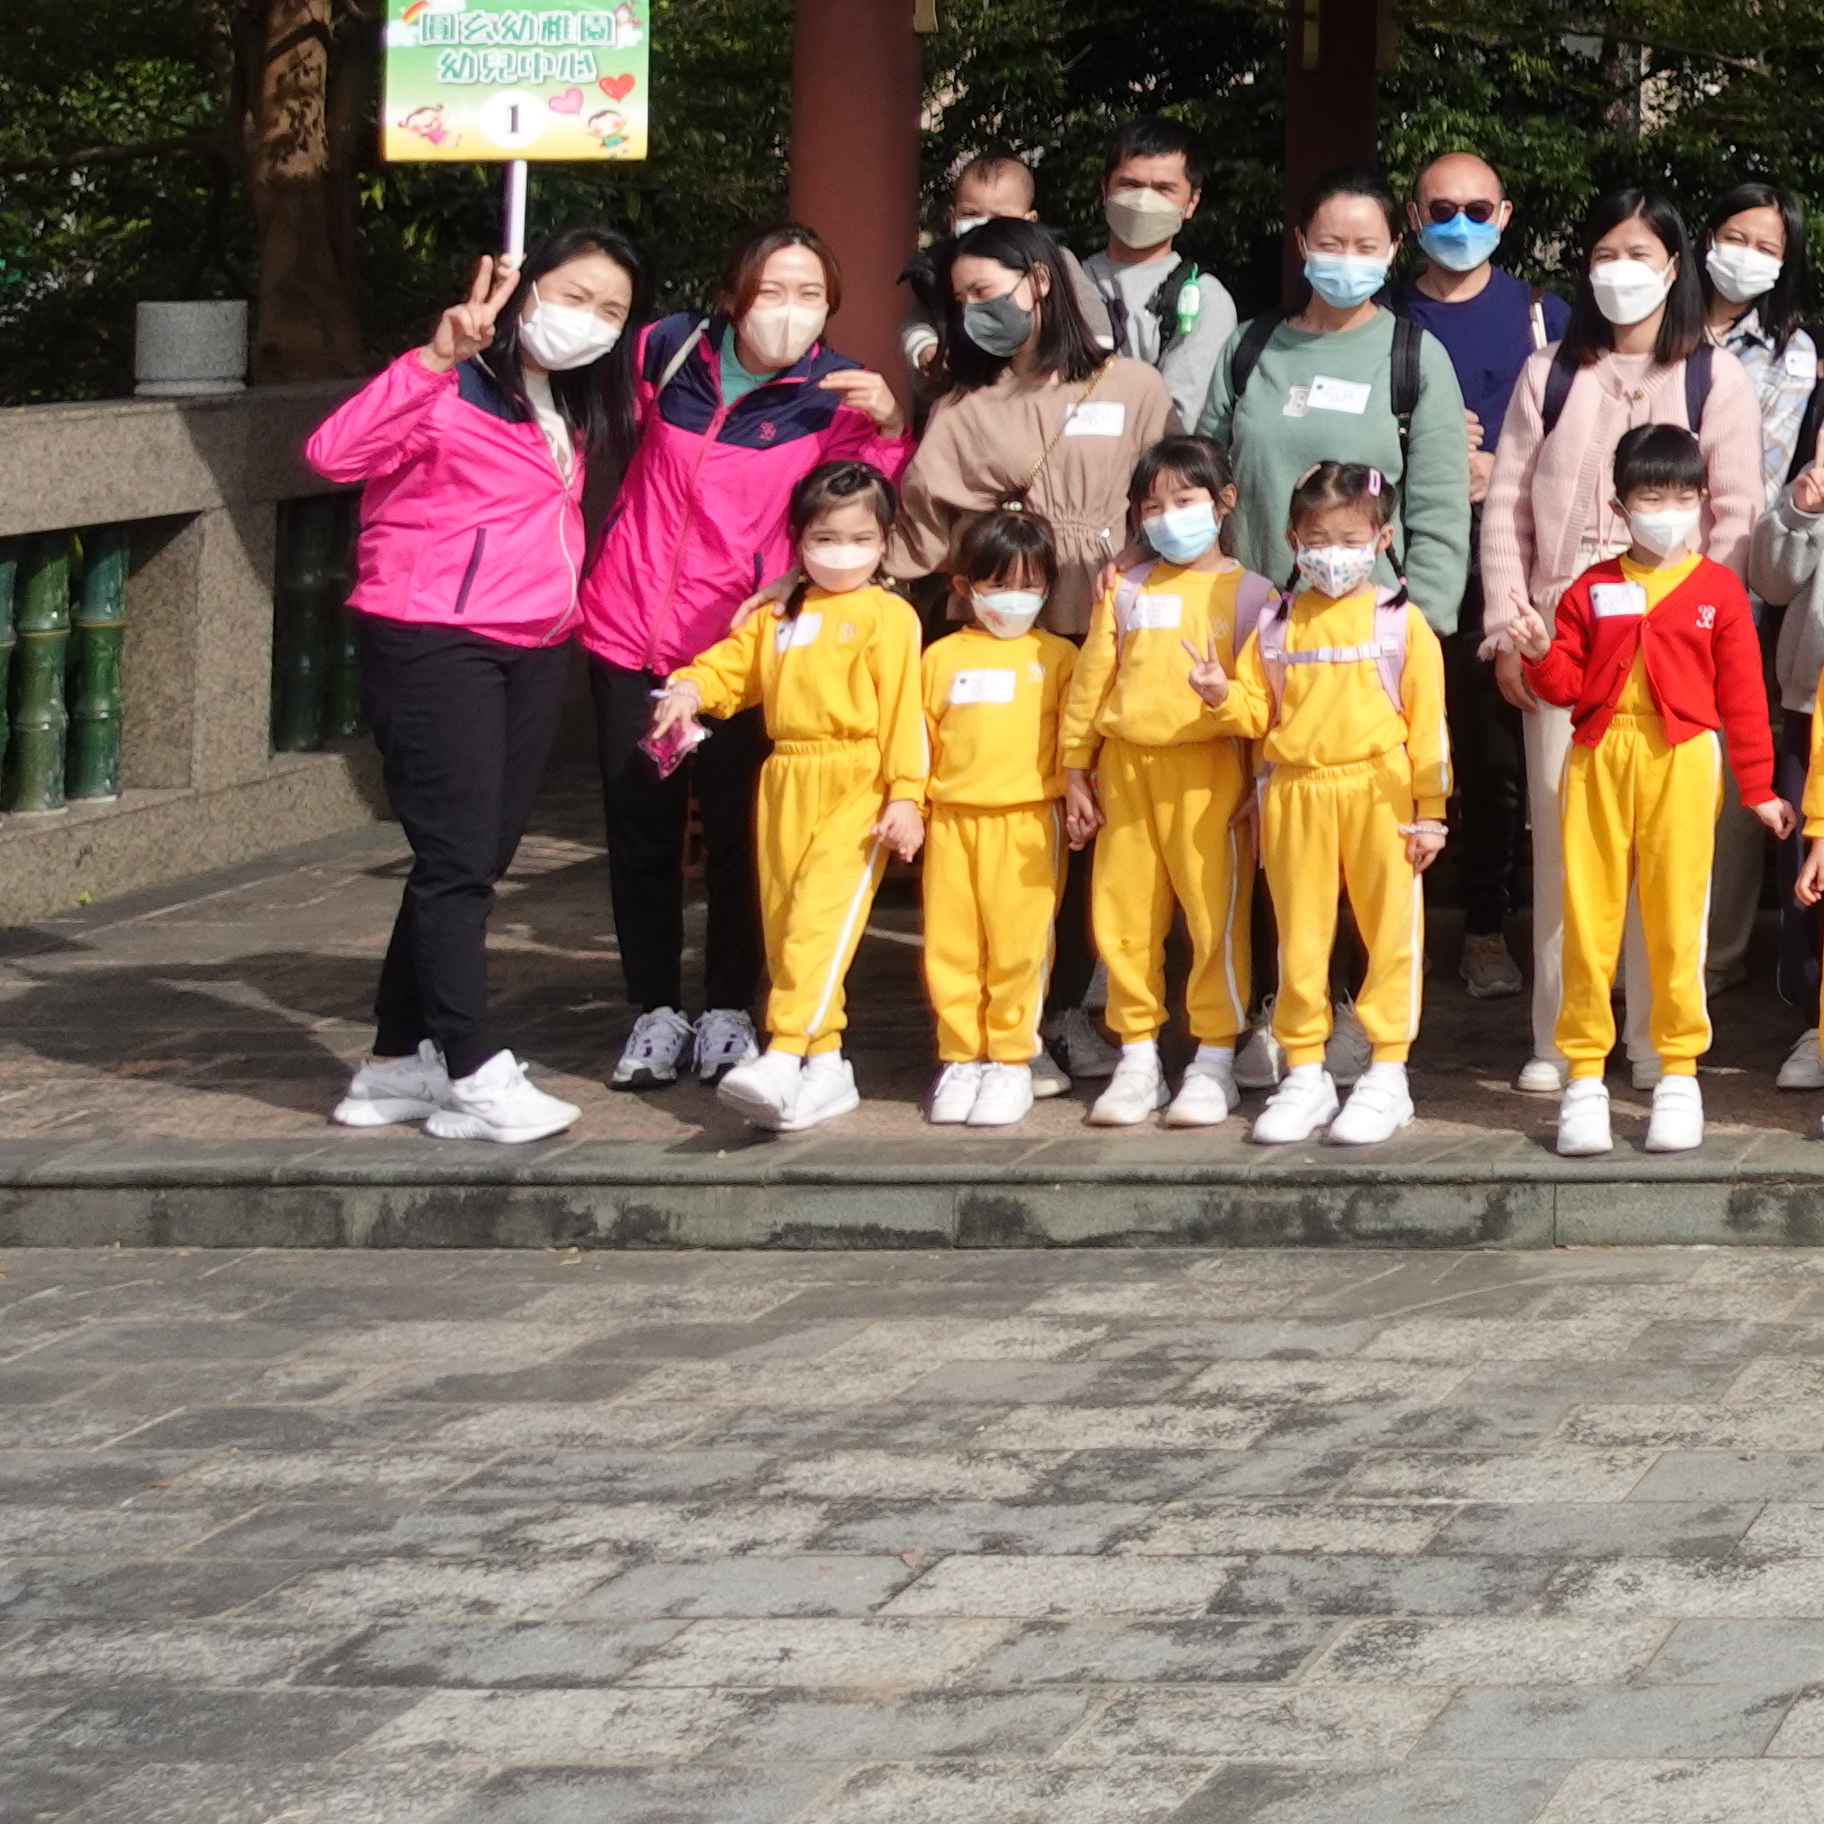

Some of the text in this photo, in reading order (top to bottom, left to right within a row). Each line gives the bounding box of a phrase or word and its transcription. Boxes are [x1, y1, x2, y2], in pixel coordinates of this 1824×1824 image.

[419, 10, 617, 46] 圓玄幼稚園
[438, 49, 598, 84] 幼兒中心
[504, 104, 520, 134] 1
